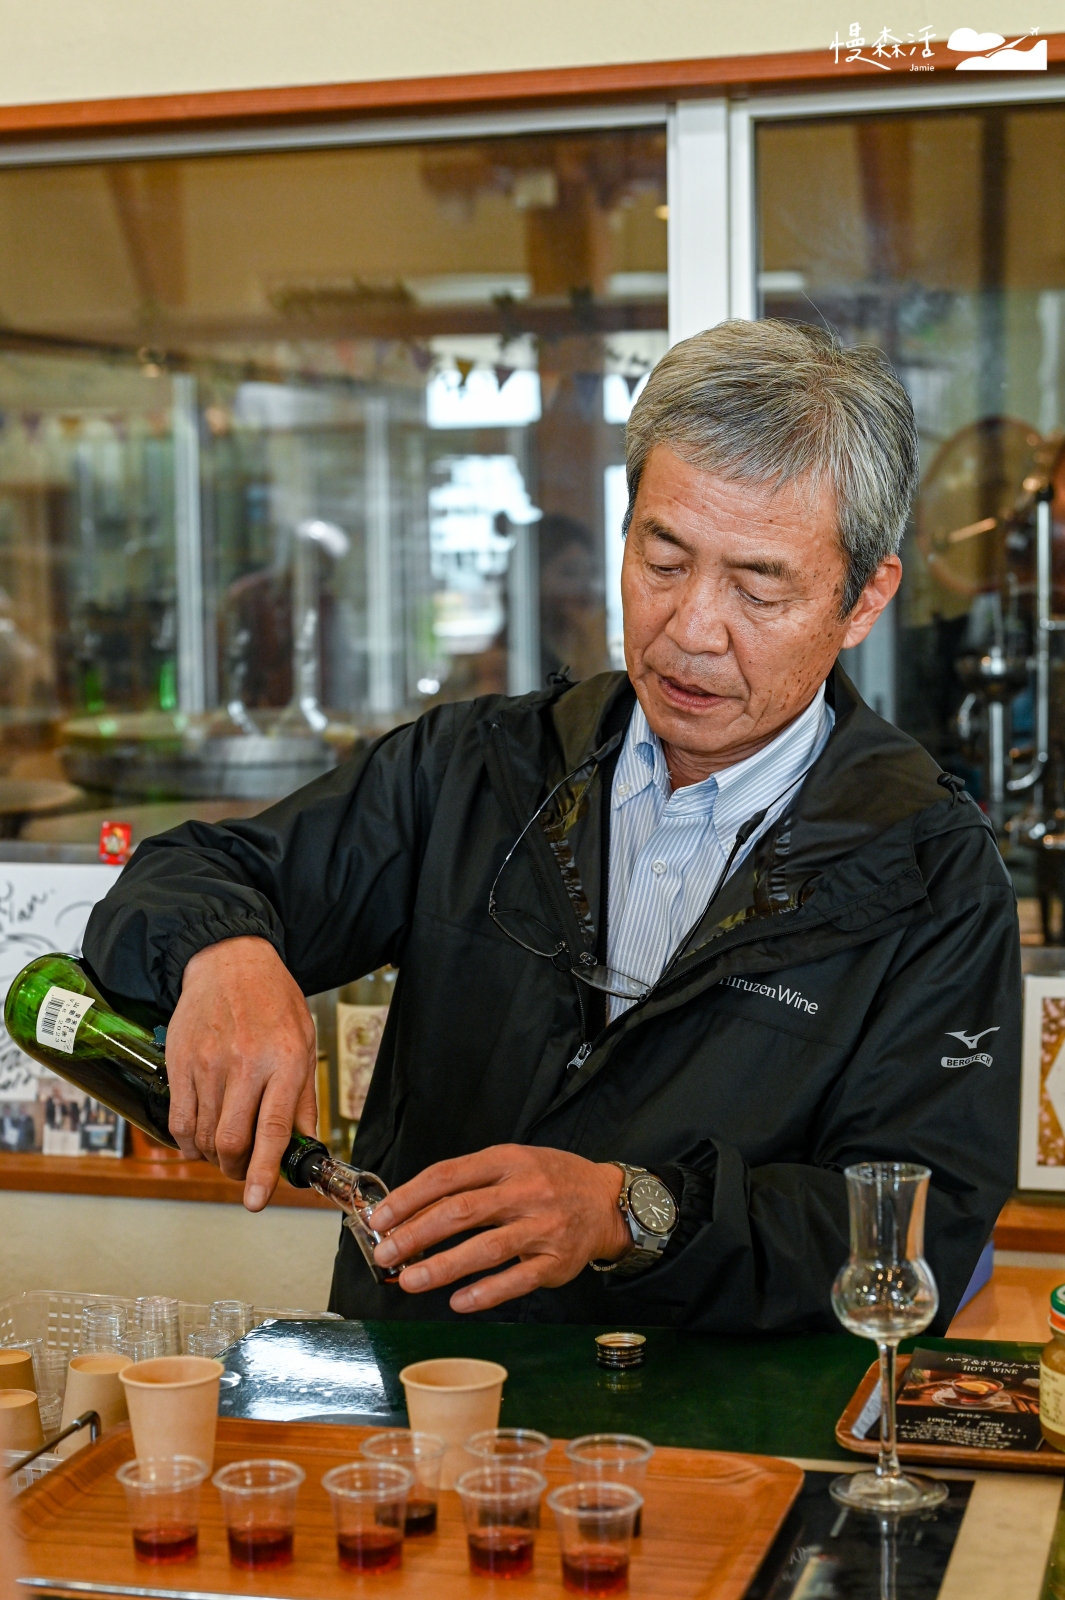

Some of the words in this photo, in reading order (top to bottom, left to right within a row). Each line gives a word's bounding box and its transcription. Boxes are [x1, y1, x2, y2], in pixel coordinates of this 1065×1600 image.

[946, 1054, 991, 1067] BERGTECH
[963, 1365, 986, 1373] HOT
[992, 1367, 1019, 1375] WINE
